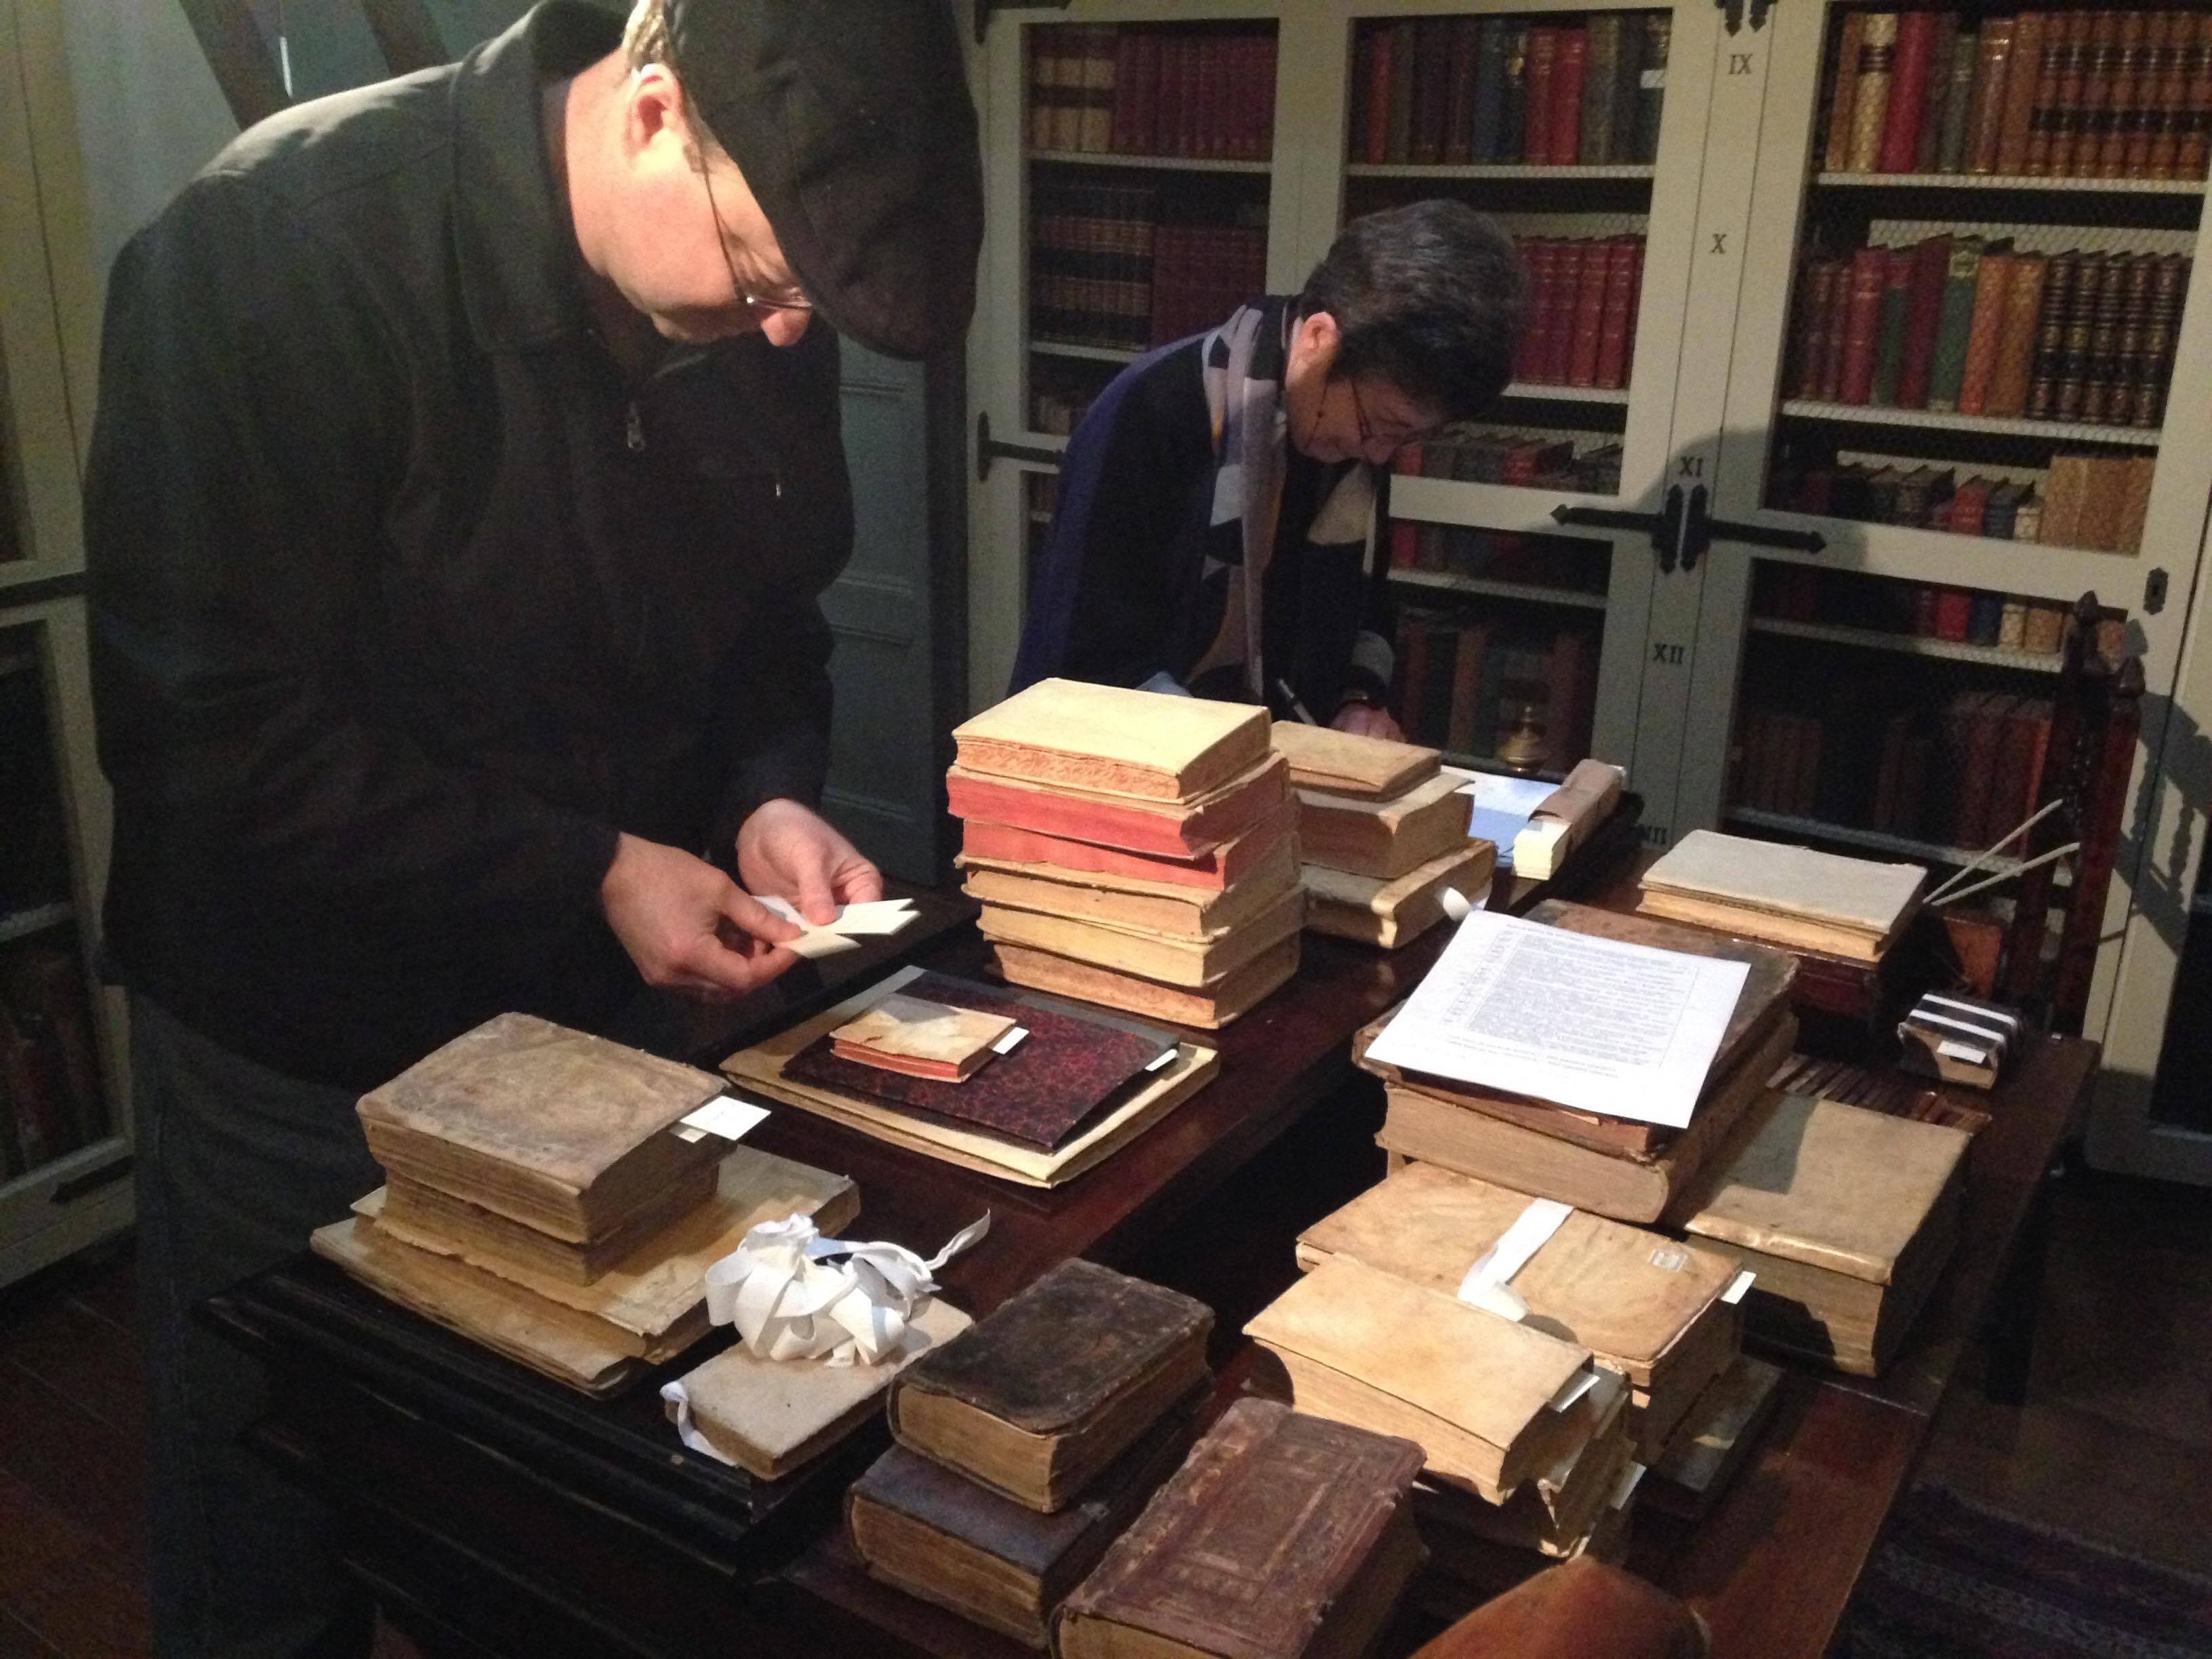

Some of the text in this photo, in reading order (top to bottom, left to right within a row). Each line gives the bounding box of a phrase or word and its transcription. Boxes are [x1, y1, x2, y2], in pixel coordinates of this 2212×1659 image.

[1729, 54, 1753, 75] IX
[1710, 233, 1727, 253] X
[1679, 456, 1704, 477] XI
[1652, 643, 1683, 664] XII
